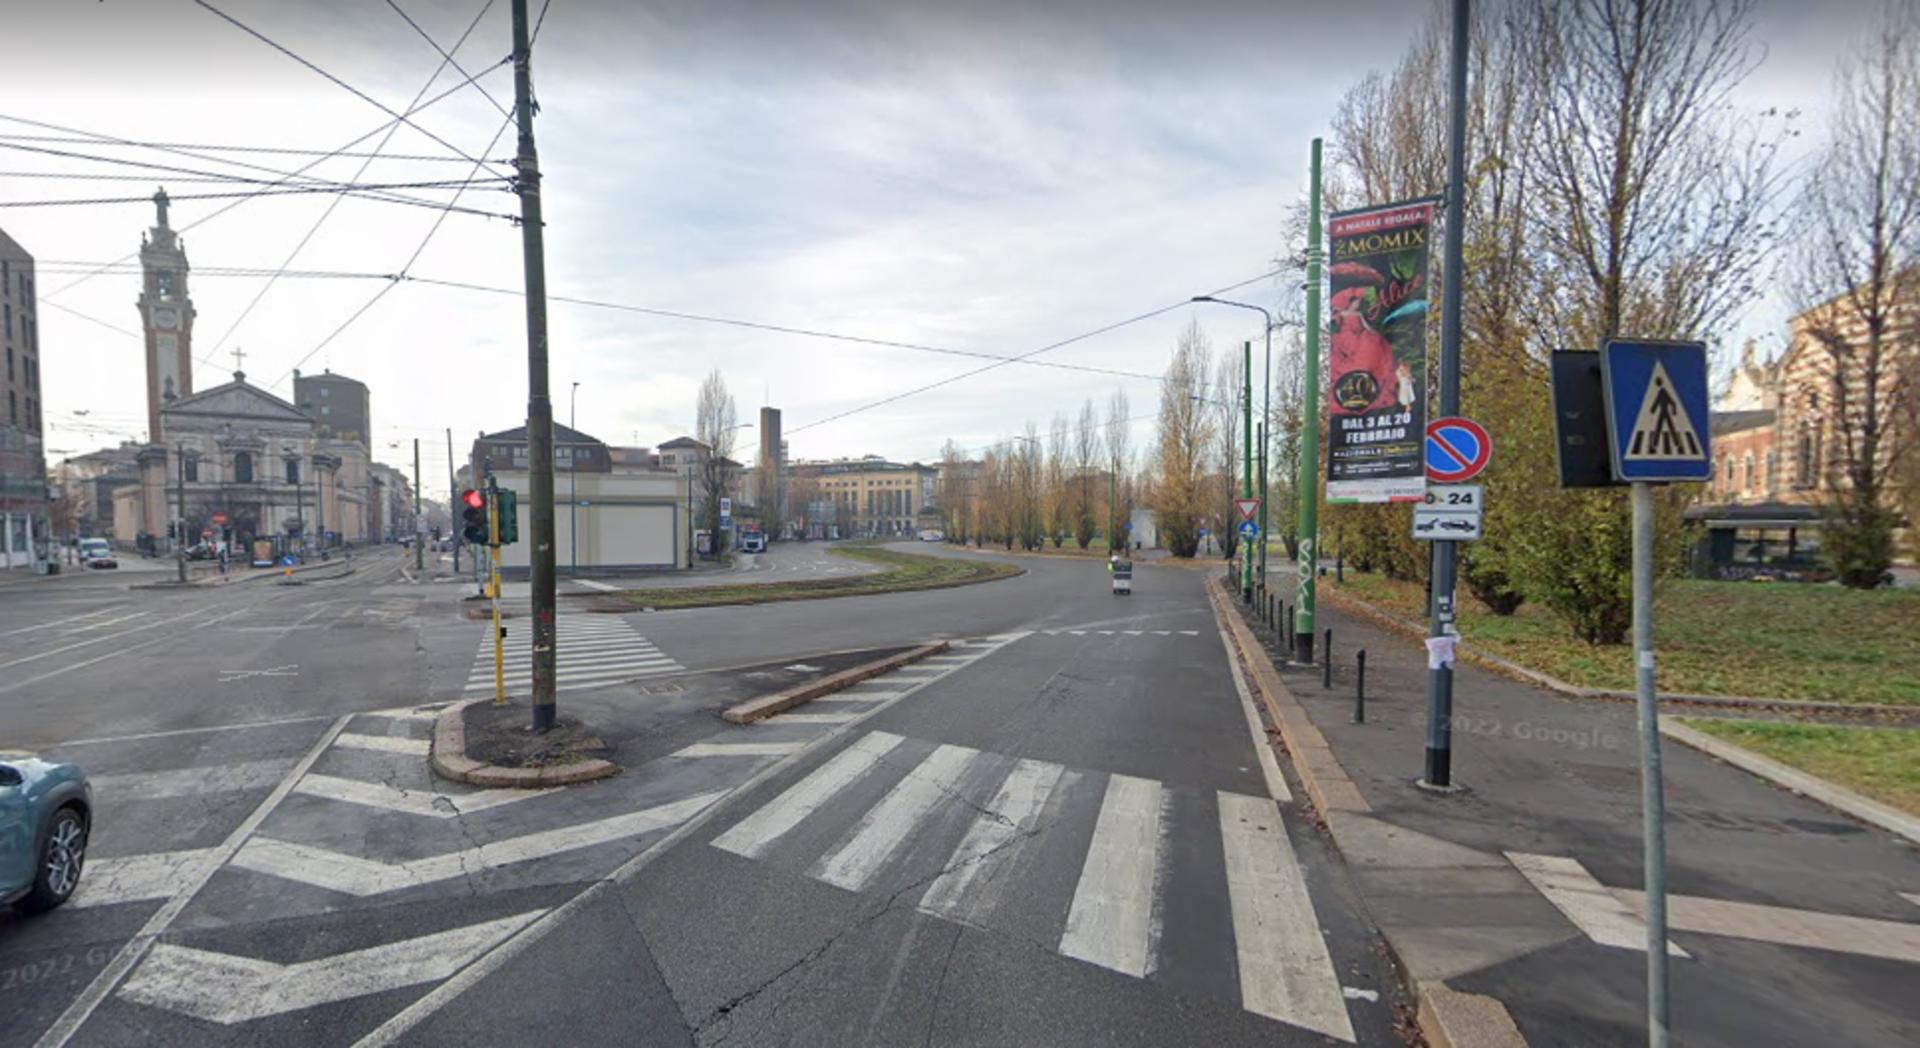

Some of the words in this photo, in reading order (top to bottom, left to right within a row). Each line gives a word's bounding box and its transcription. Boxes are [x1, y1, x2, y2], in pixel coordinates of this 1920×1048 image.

[1349, 229, 1424, 254] MOMIX
[1342, 417, 1364, 430] DAL
[1366, 416, 1375, 428] 3
[1377, 415, 1392, 428] AL
[1394, 413, 1411, 426] 20
[1345, 428, 1406, 444] FEBBRAIO
[1448, 492, 1473, 505] 24
